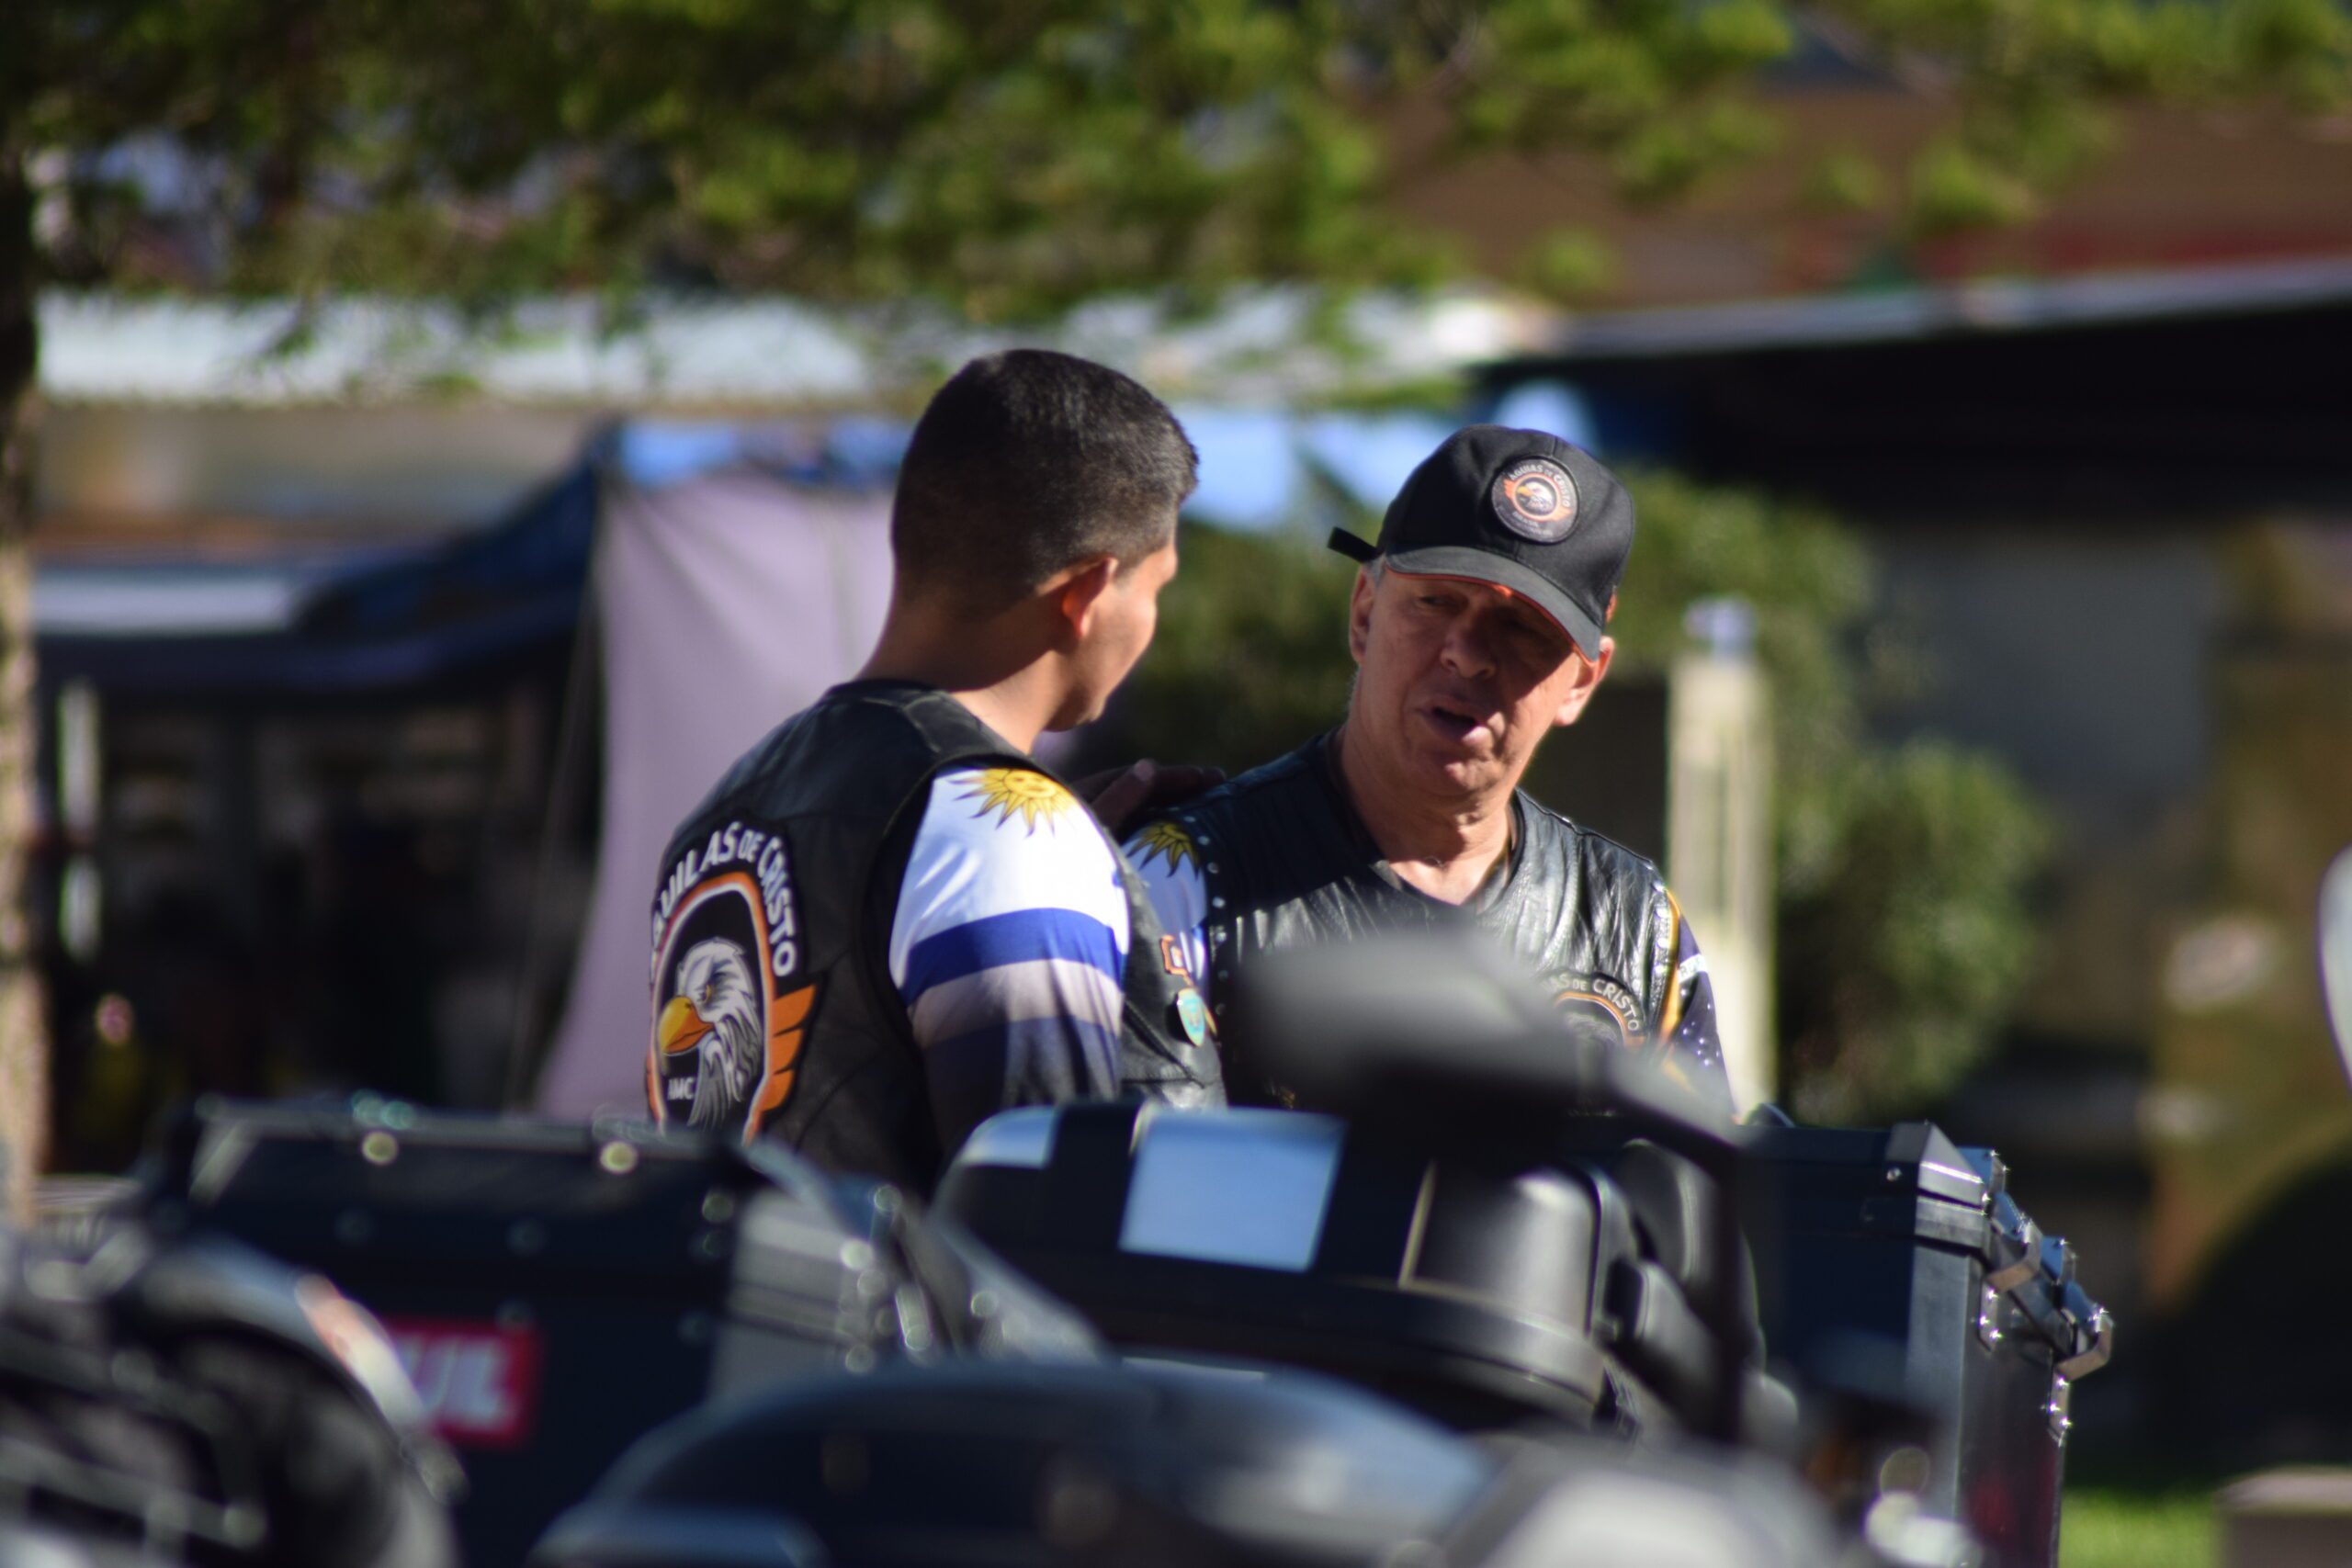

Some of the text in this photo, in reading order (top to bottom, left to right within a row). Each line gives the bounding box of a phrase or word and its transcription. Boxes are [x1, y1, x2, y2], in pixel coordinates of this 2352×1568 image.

[737, 829, 764, 863] DE
[757, 837, 796, 976] CRISTO
[1572, 978, 1588, 991] DE
[1592, 978, 1639, 1031] CRISTO
